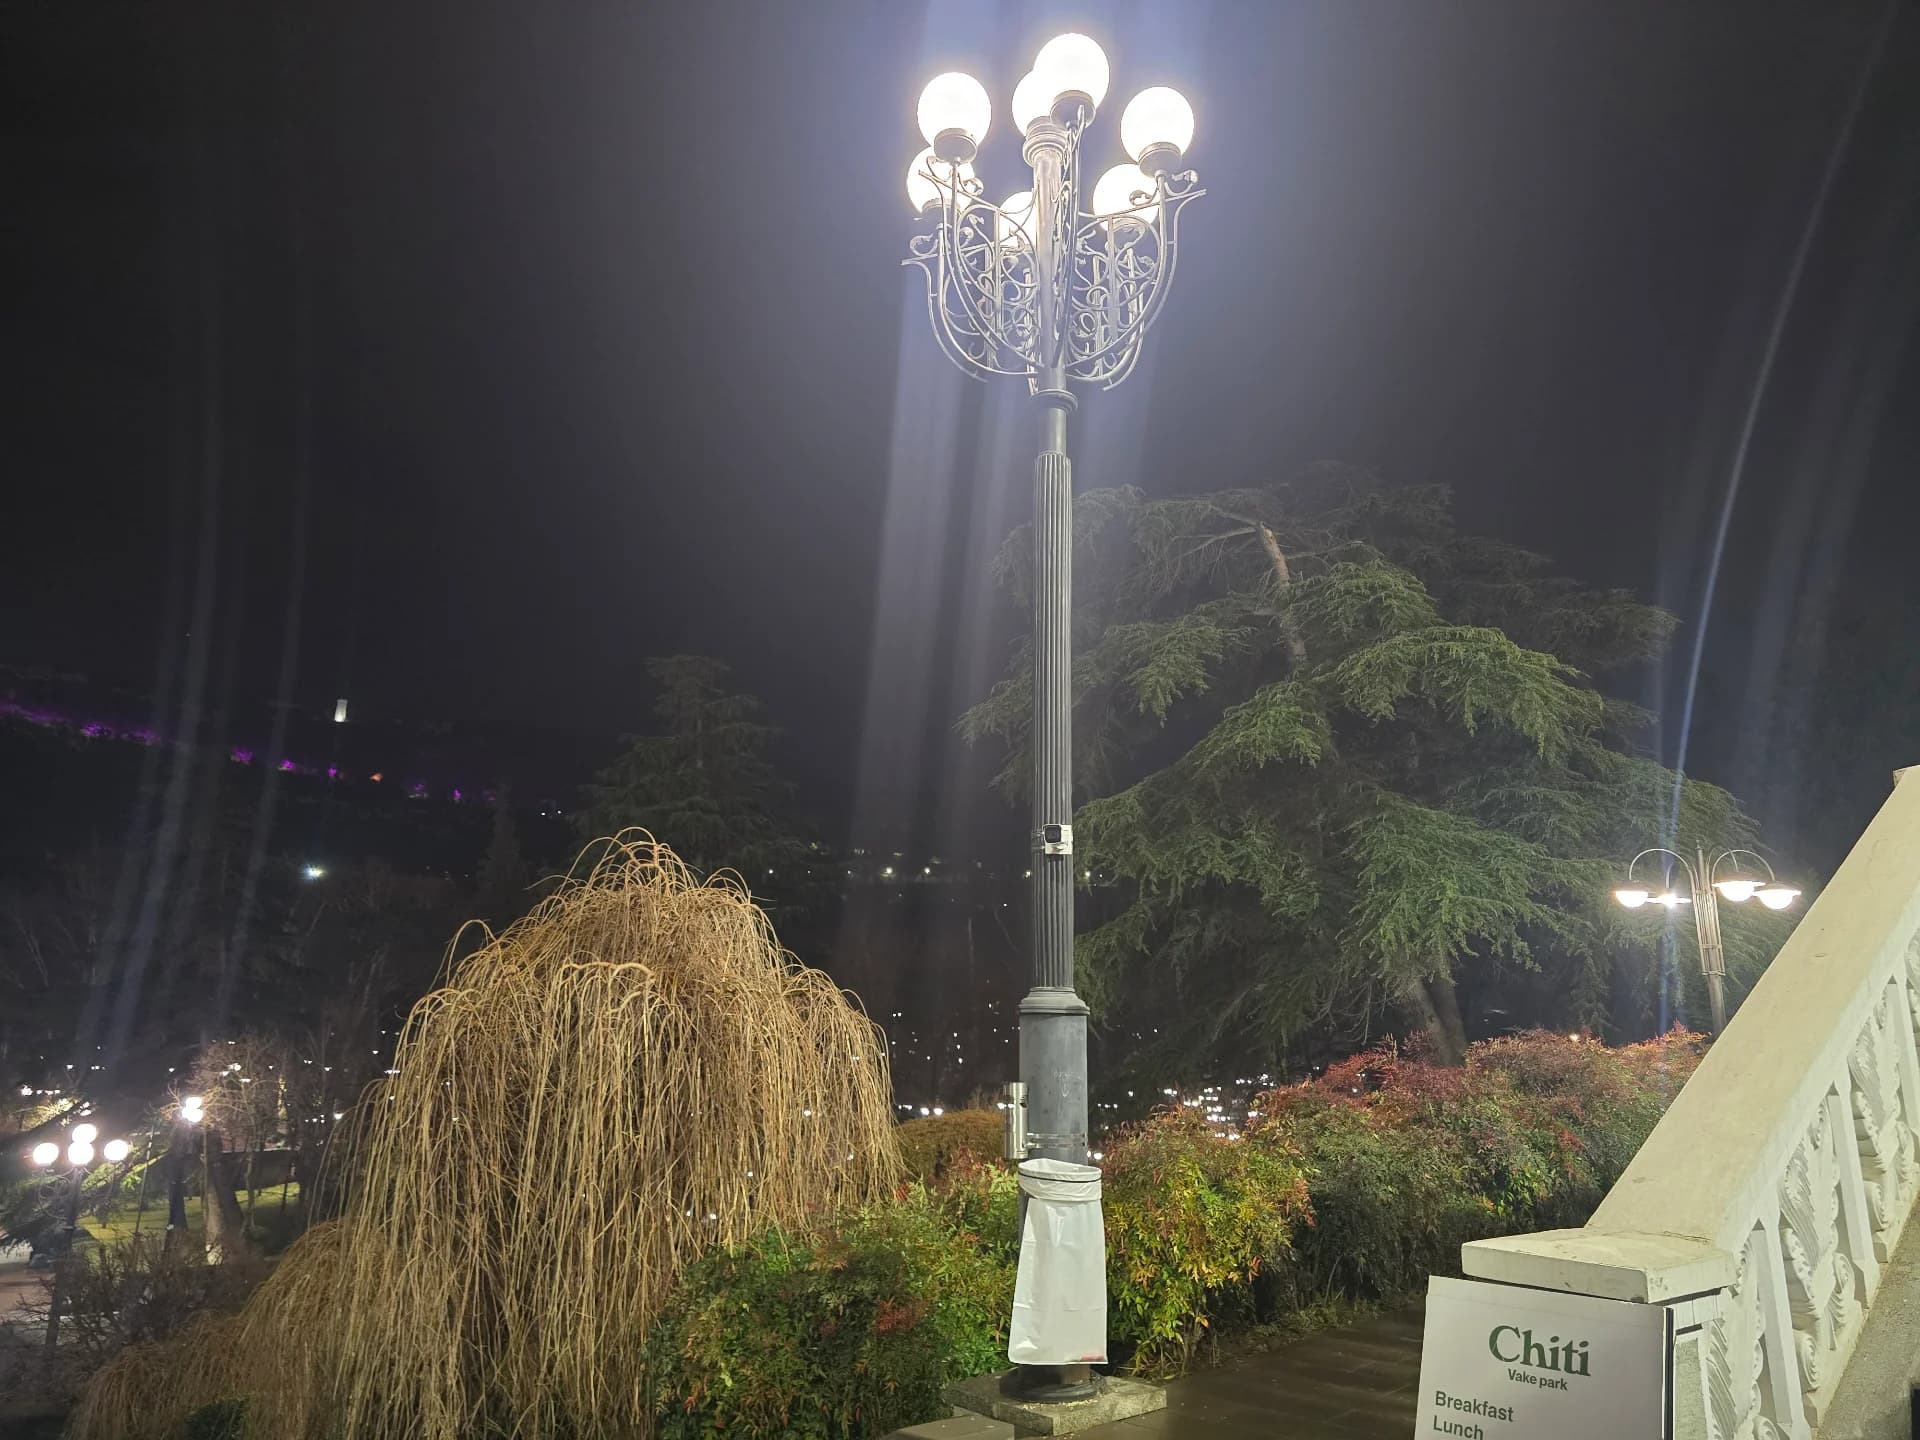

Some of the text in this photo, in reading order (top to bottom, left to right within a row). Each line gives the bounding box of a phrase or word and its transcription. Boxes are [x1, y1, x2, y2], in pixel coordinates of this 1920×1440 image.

[1489, 1325, 1591, 1376] Chiti
[1508, 1369, 1568, 1391] Vake park
[1435, 1391, 1514, 1422] Breakfast
[1433, 1415, 1484, 1440] Lunch
